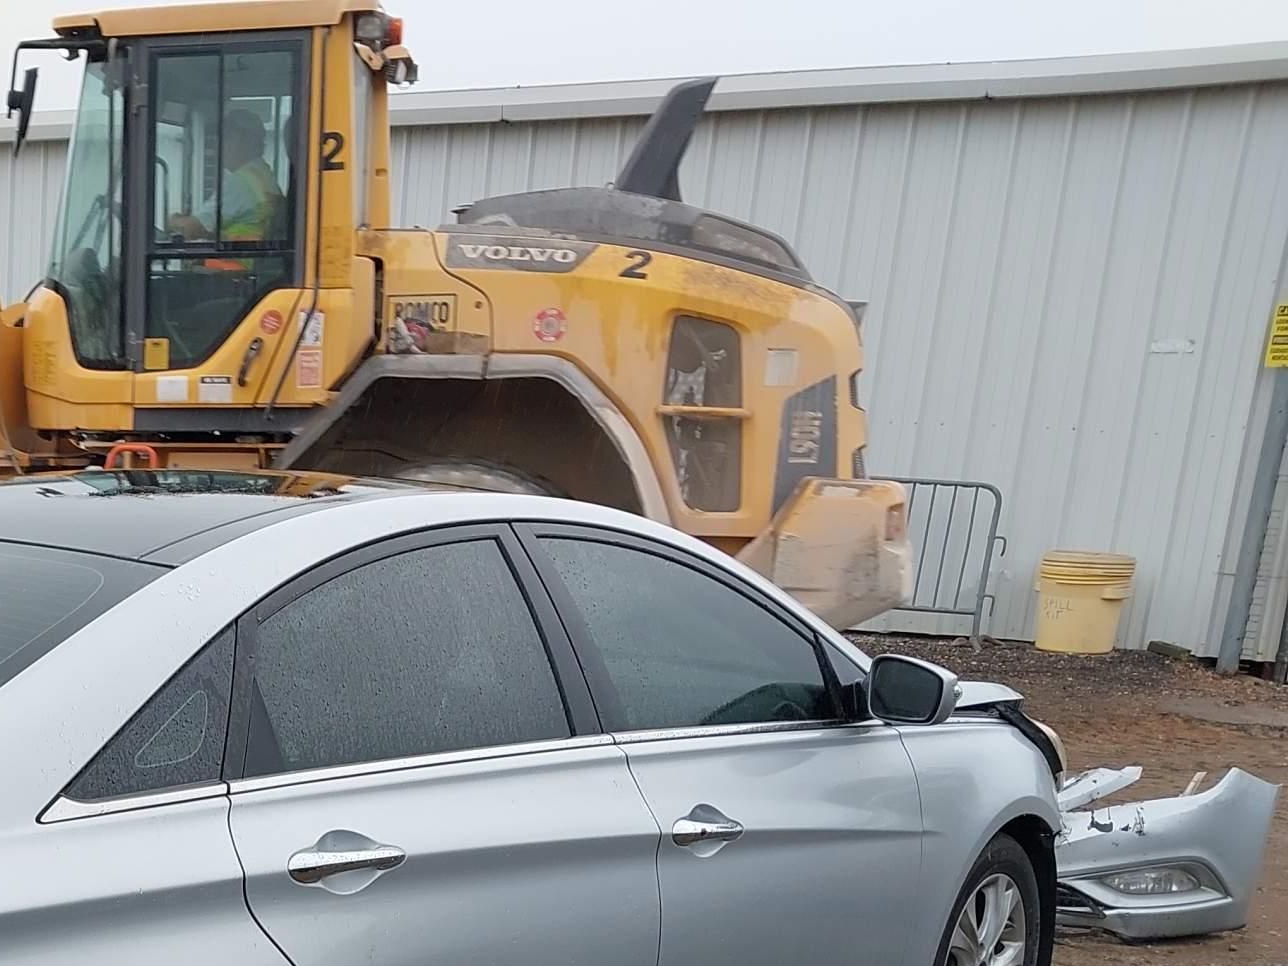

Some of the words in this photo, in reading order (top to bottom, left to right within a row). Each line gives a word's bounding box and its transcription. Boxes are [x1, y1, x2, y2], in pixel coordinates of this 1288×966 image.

[320, 132, 344, 170] 2
[459, 244, 577, 263] VOLVO
[619, 249, 652, 279] 2
